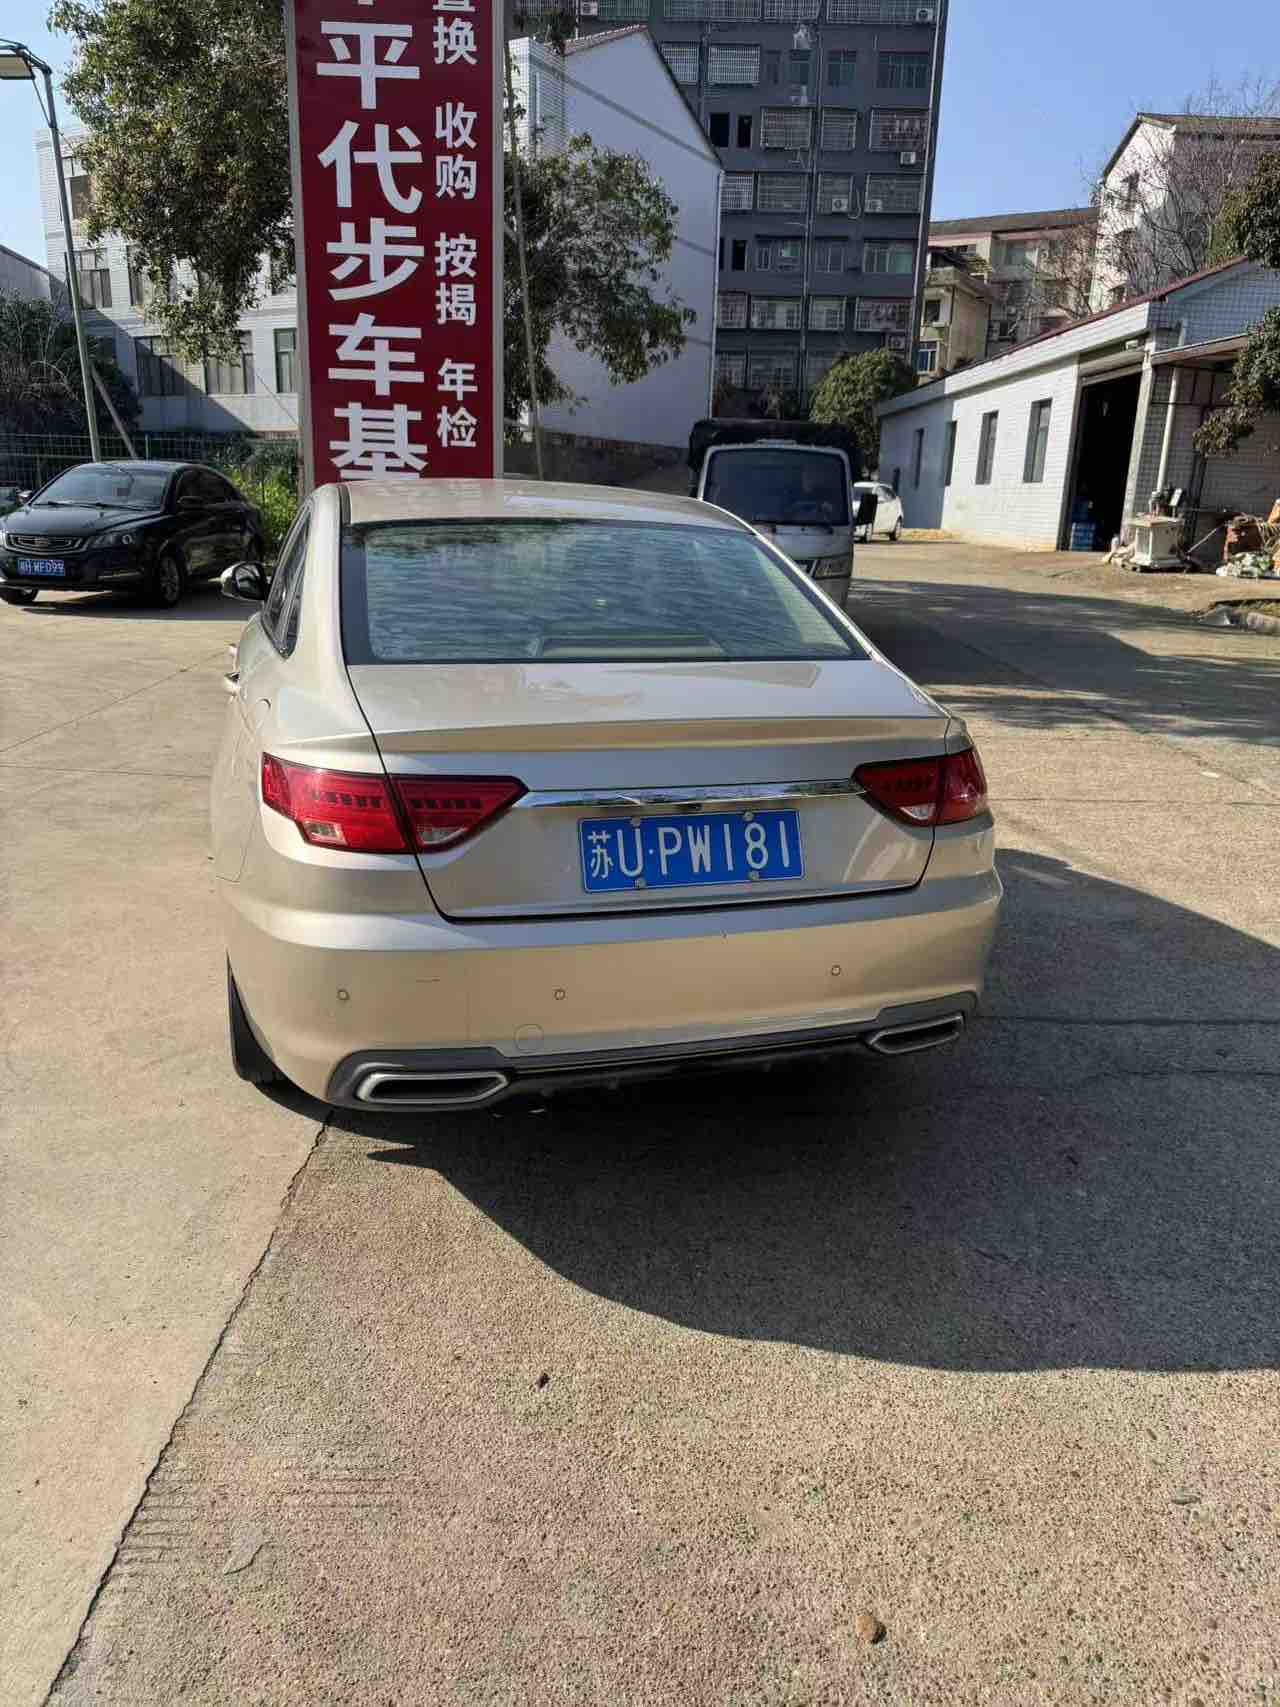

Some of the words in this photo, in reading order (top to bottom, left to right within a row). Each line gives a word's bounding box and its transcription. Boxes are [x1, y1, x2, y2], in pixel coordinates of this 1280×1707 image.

[432, 0, 478, 65] 换
[434, 102, 478, 200] 收购
[316, 0, 428, 481] 平代步车基
[434, 232, 477, 326] 按揭
[436, 358, 478, 448] 年检
